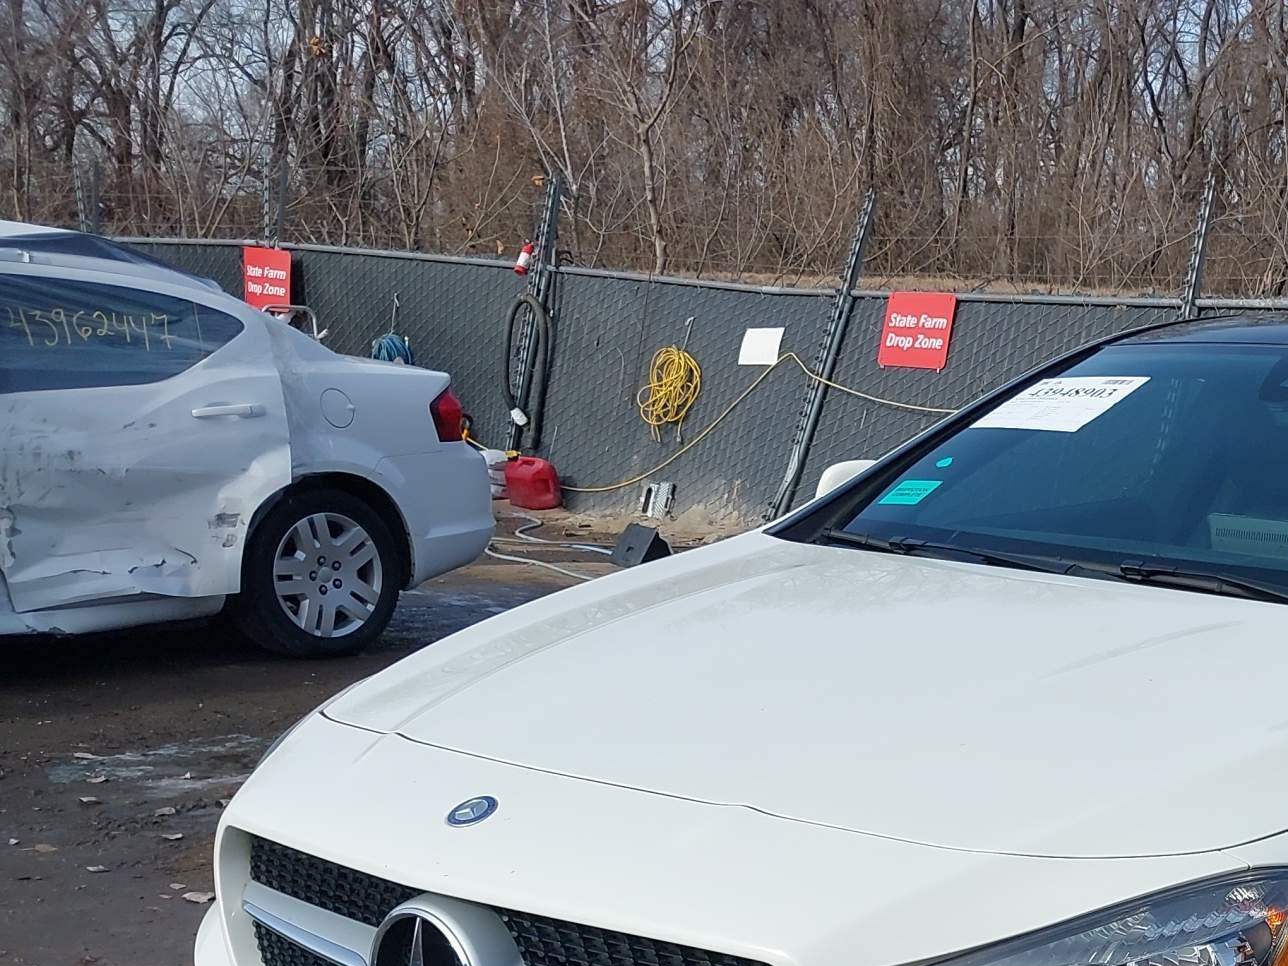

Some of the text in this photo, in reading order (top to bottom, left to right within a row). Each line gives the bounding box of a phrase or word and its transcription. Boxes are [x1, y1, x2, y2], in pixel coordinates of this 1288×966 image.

[247, 265, 286, 279] State Farm
[248, 281, 286, 296] Drop Zone
[6, 306, 176, 352] 43962447
[889, 313, 947, 329] State Farm
[886, 333, 943, 350] Drop Zone
